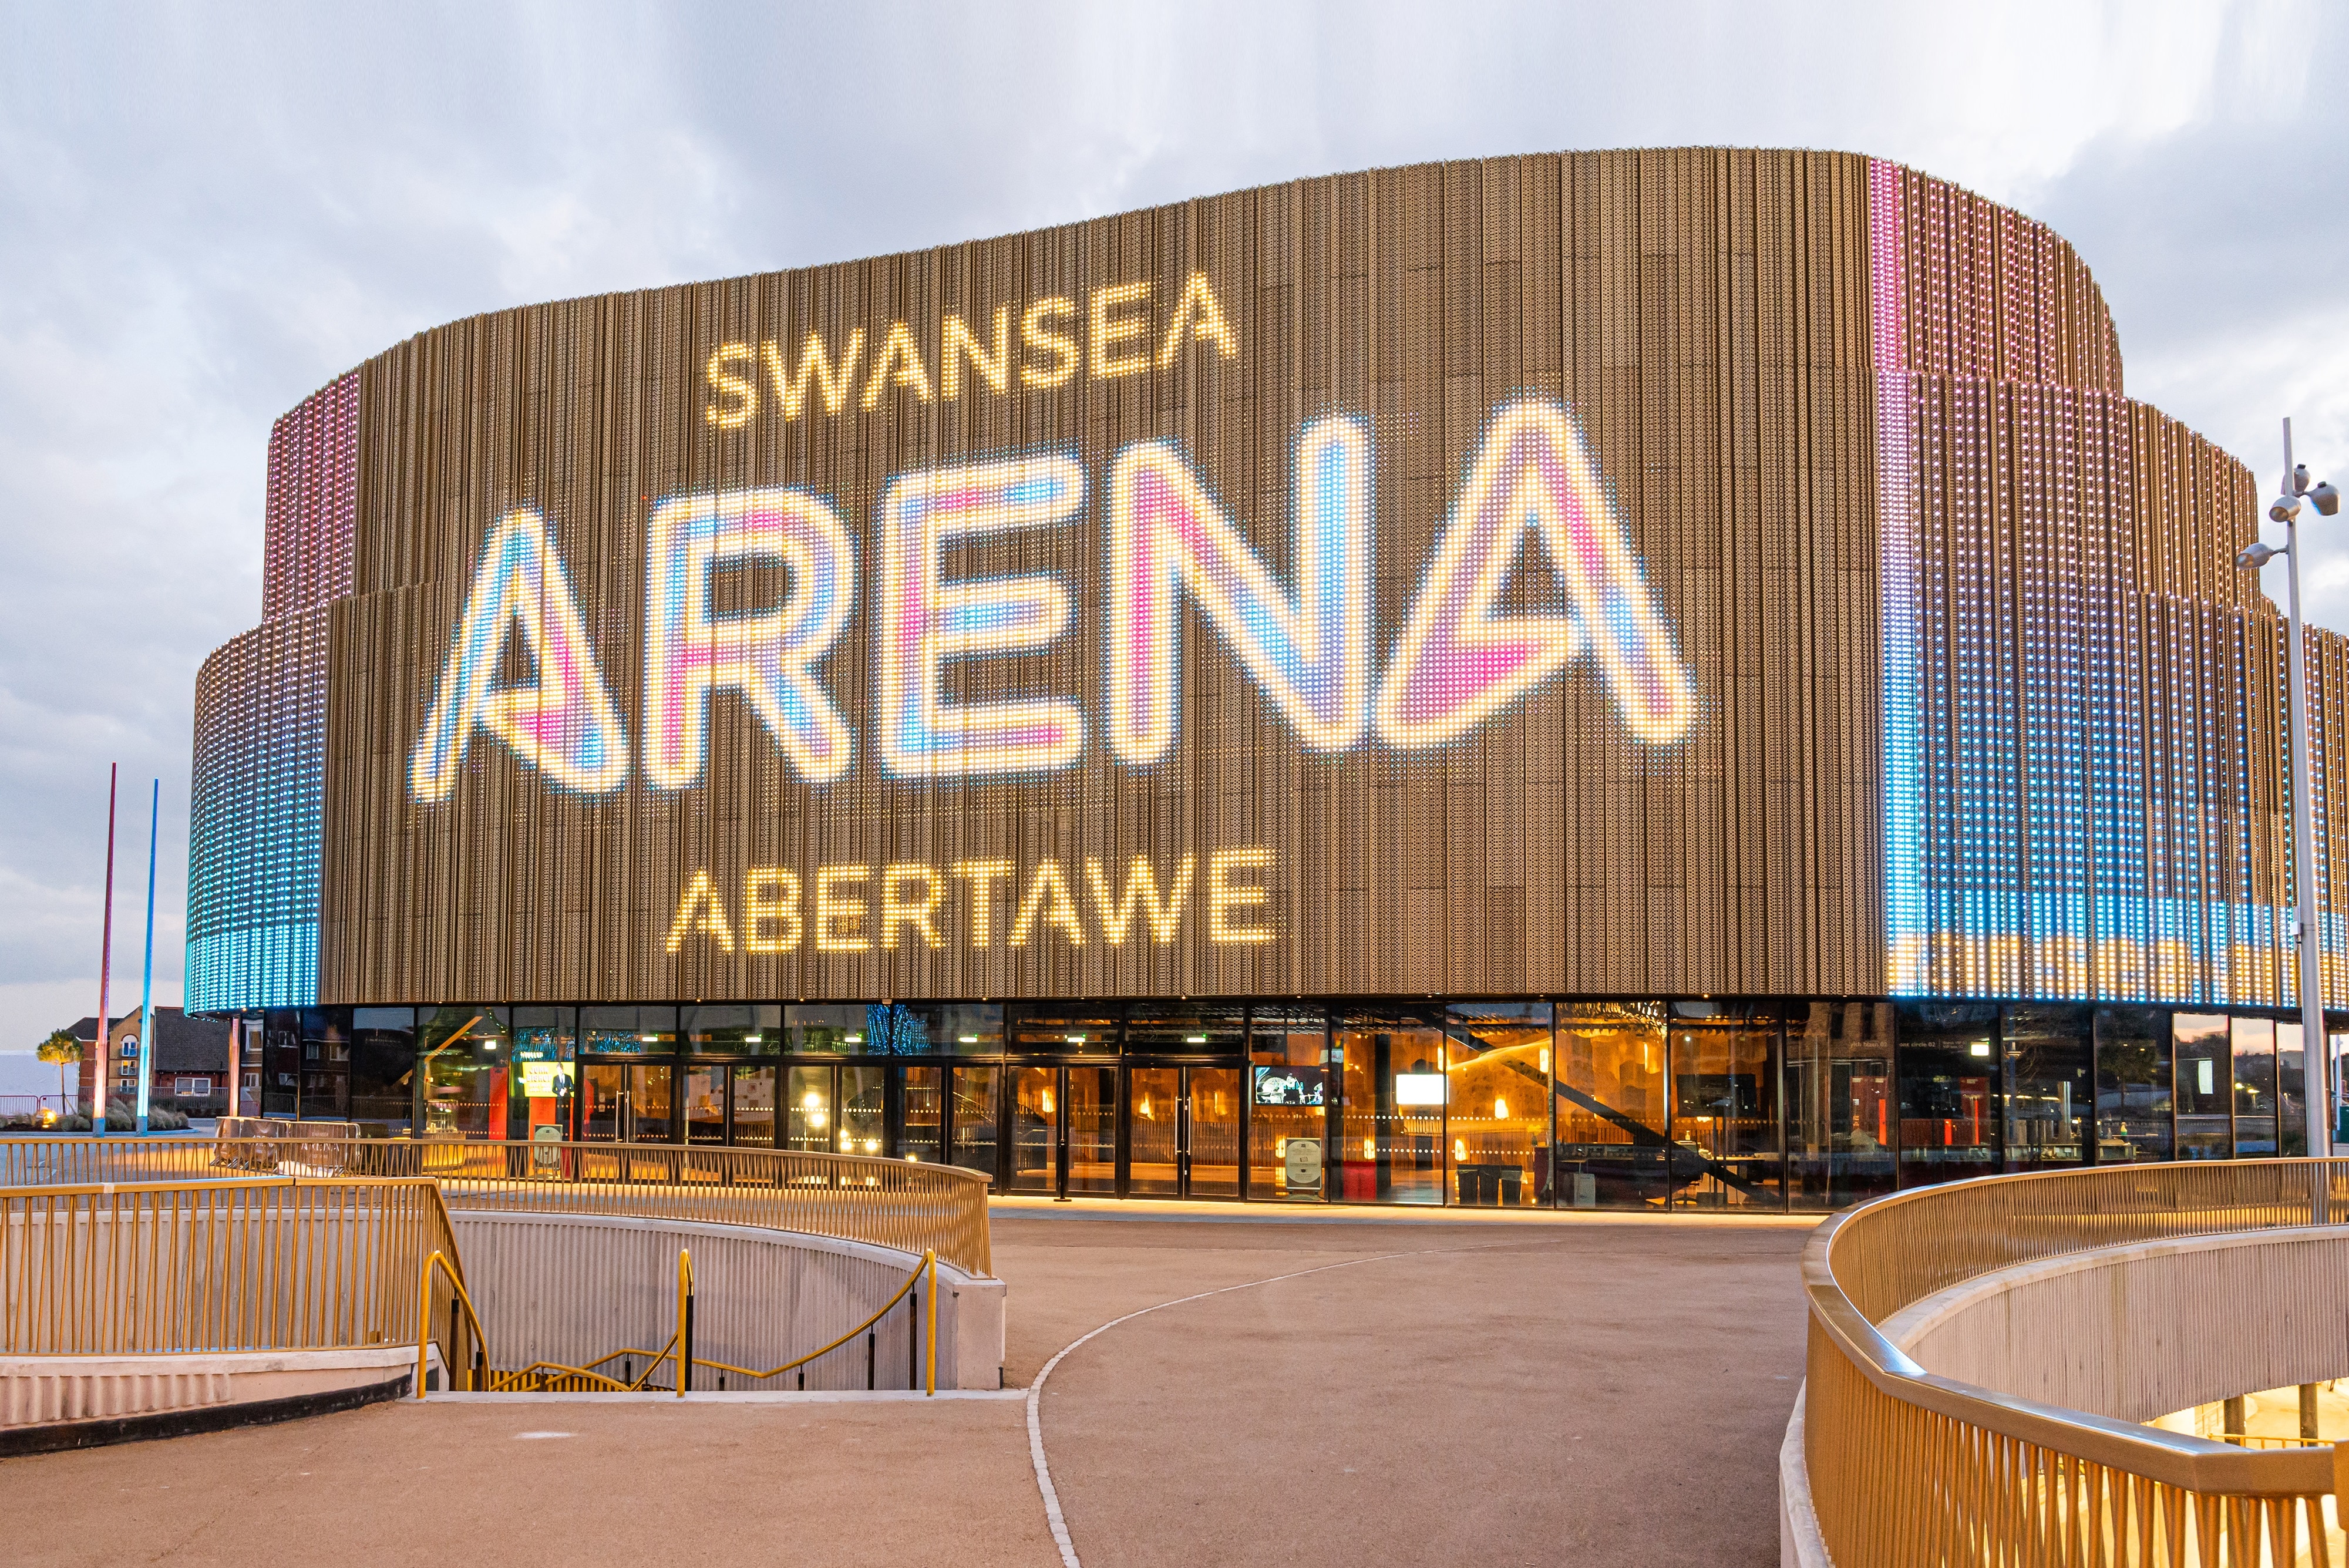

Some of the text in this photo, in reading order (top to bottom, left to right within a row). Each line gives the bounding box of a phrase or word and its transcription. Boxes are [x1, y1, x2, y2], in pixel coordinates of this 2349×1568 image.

[704, 270, 1240, 430] SWANSEA
[406, 393, 1703, 803] ARENA
[665, 846, 1274, 954] ABERTAWE
[526, 1074, 552, 1082] BISHOP
[529, 1065, 548, 1074] JOHN
